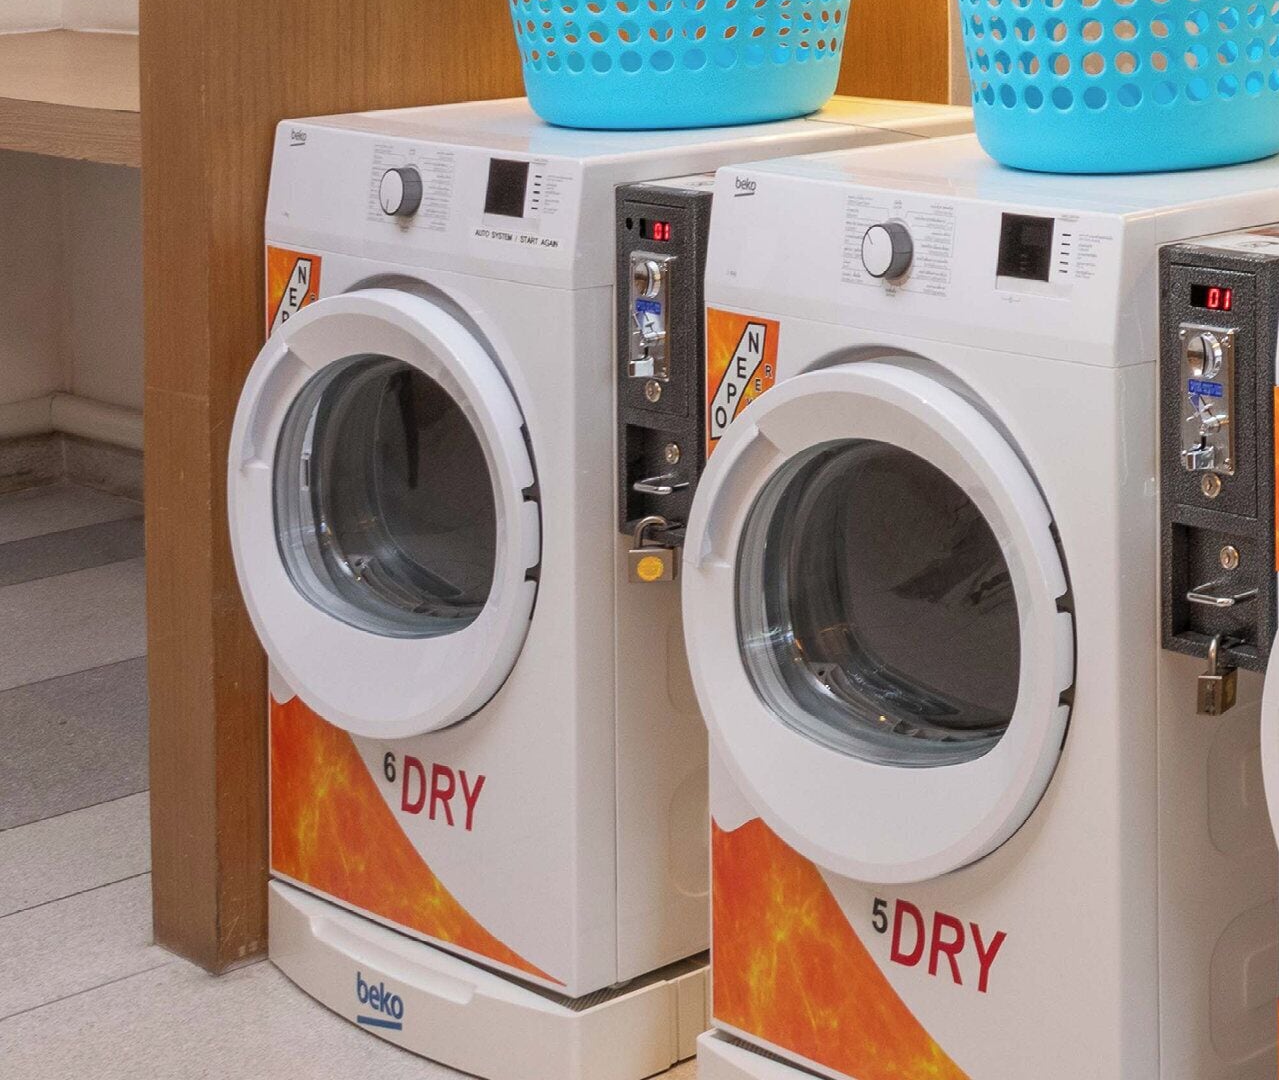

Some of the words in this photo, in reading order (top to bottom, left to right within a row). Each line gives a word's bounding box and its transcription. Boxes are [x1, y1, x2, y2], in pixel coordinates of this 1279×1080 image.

[735, 176, 757, 191] beko
[475, 229, 490, 238] AUTO
[491, 231, 513, 242] SYSTEM
[520, 235, 538, 245] START
[541, 238, 558, 248] AGAIN
[654, 222, 670, 240] 01
[1207, 287, 1230, 309] 01
[715, 331, 760, 428] OPEN
[383, 751, 397, 784] 6
[401, 755, 486, 831] DRY
[871, 897, 888, 934] 5
[890, 898, 1007, 993] DRY
[357, 971, 404, 1019] beko
